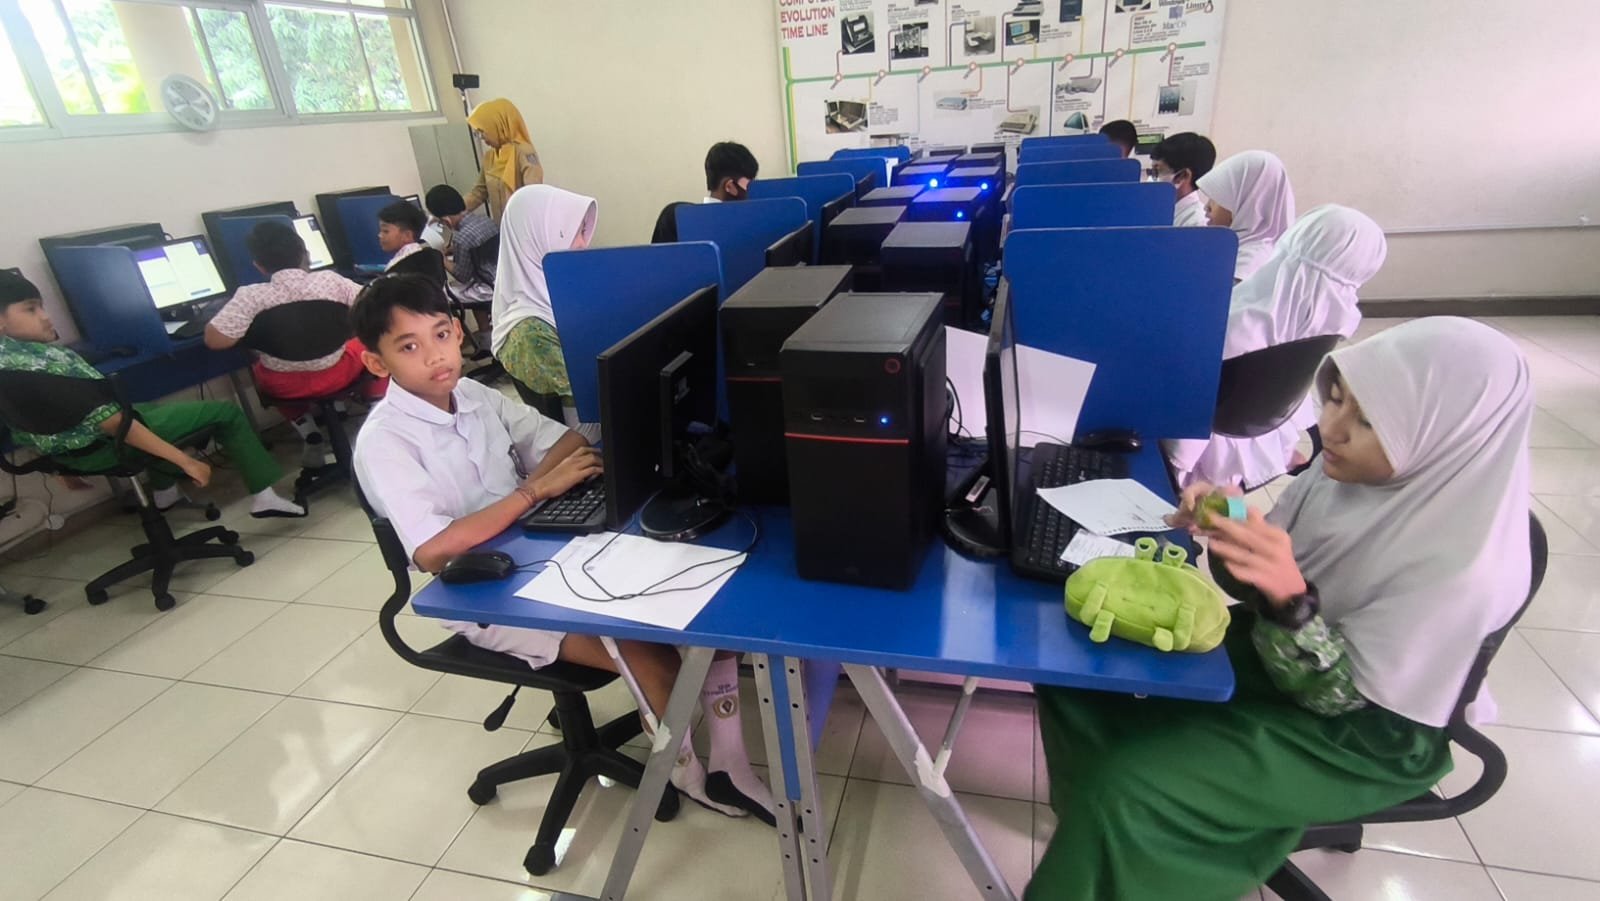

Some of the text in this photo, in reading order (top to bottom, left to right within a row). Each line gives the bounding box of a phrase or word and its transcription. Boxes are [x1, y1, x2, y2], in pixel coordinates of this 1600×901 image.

[780, 7, 835, 23] EVOLUTION
[781, 24, 829, 39] TIME LINE
